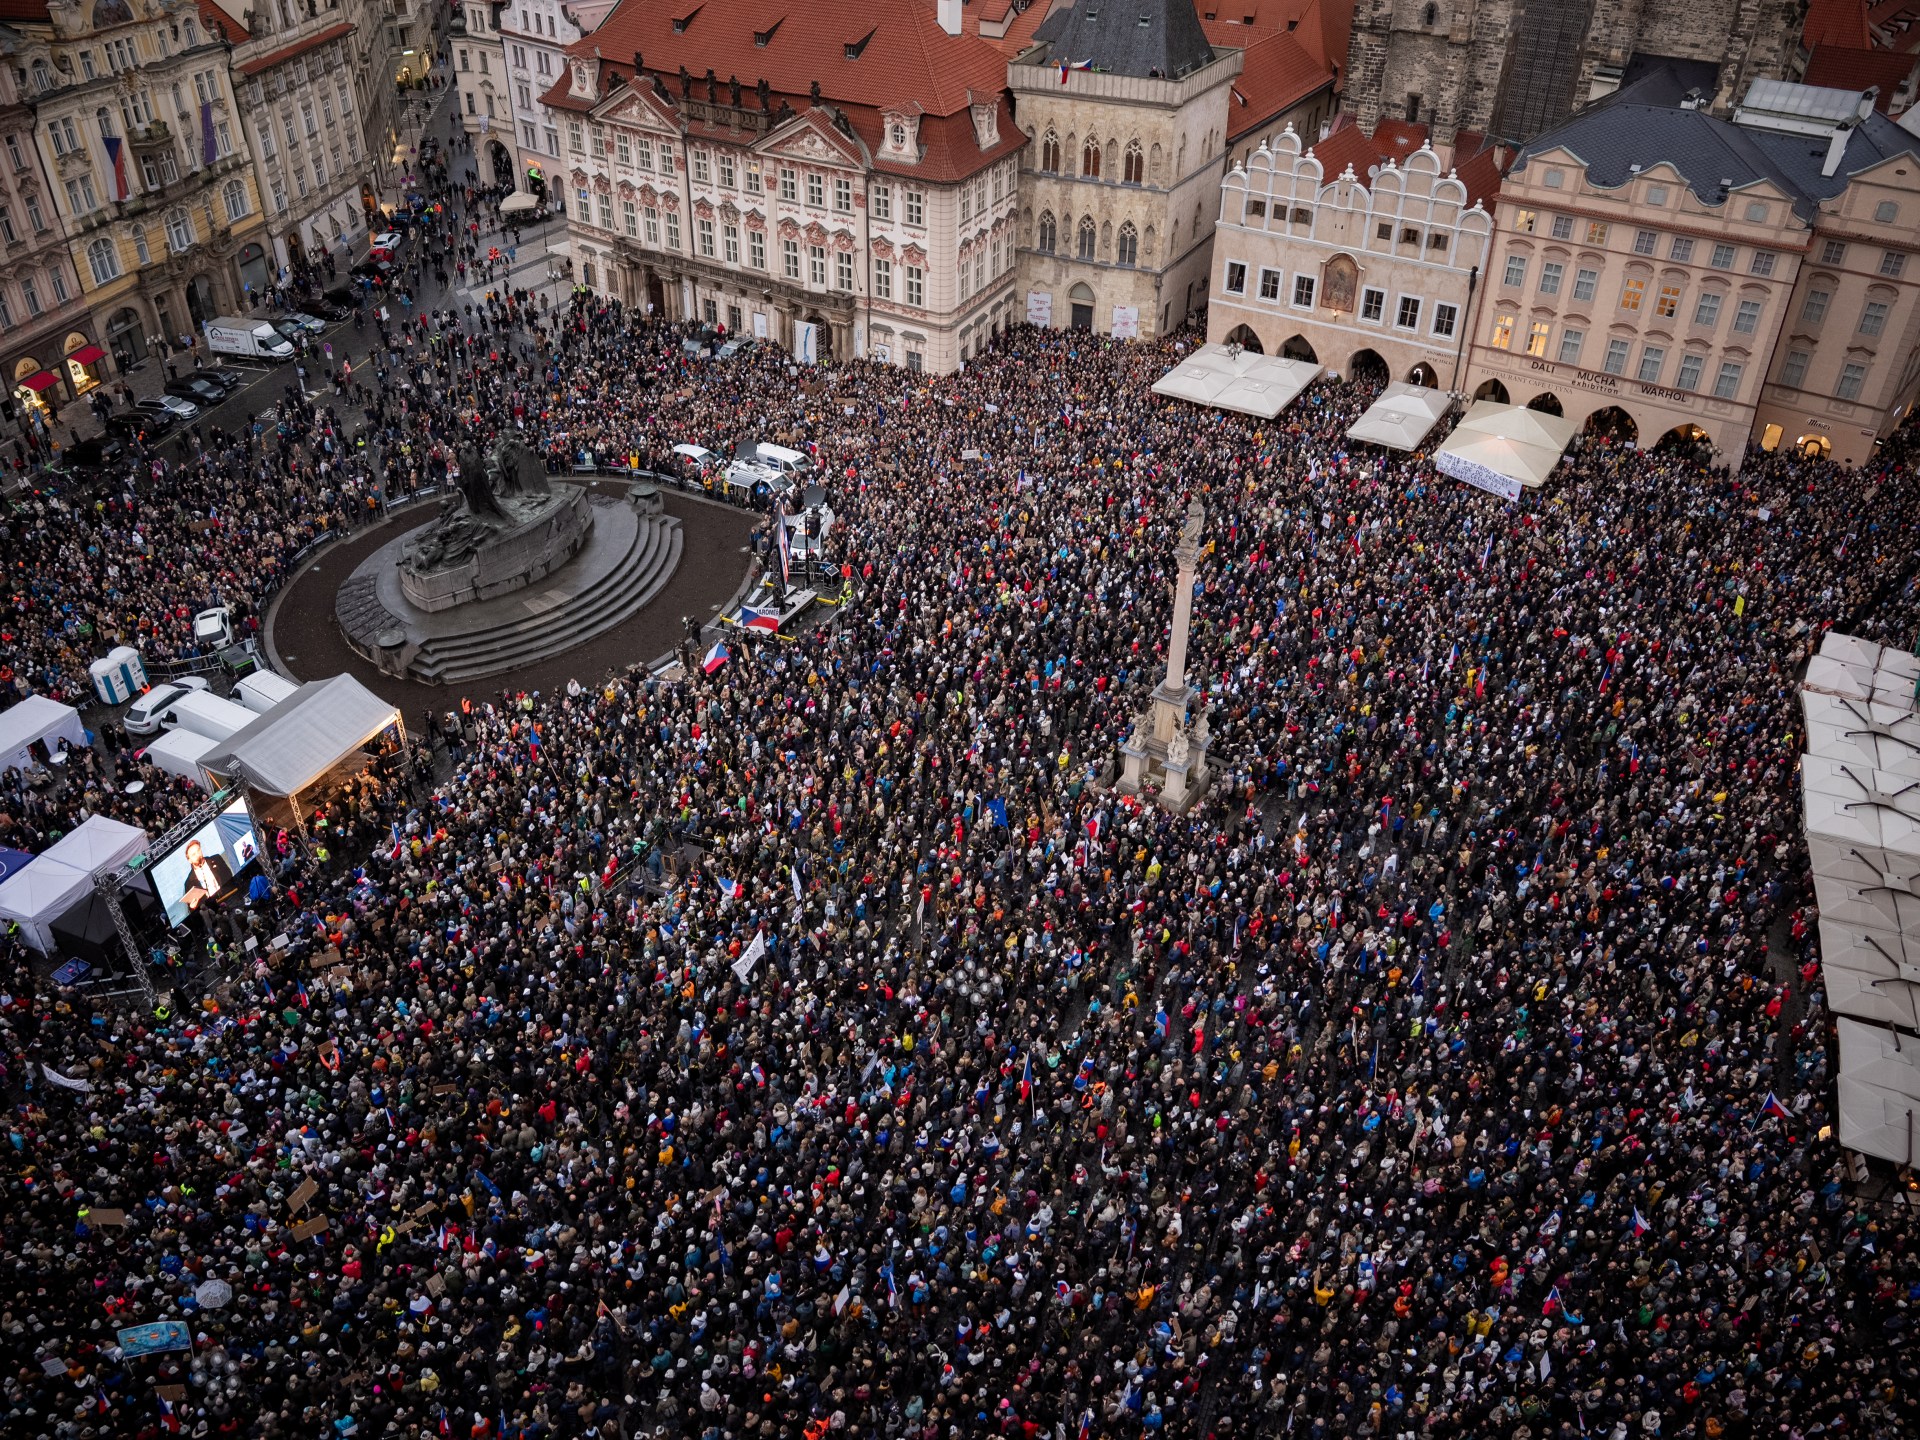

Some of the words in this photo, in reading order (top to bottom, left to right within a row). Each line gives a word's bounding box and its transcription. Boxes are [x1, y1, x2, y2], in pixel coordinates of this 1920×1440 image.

[68, 340, 84, 350] OMEGA
[20, 366, 36, 376] OMEGA
[1481, 368, 1527, 384] RESTAURANT
[1577, 371, 1616, 387] MUCHA
[1571, 380, 1618, 395] exhibition
[1641, 385, 1687, 403] WARHOL
[1807, 418, 1831, 431] Moser
